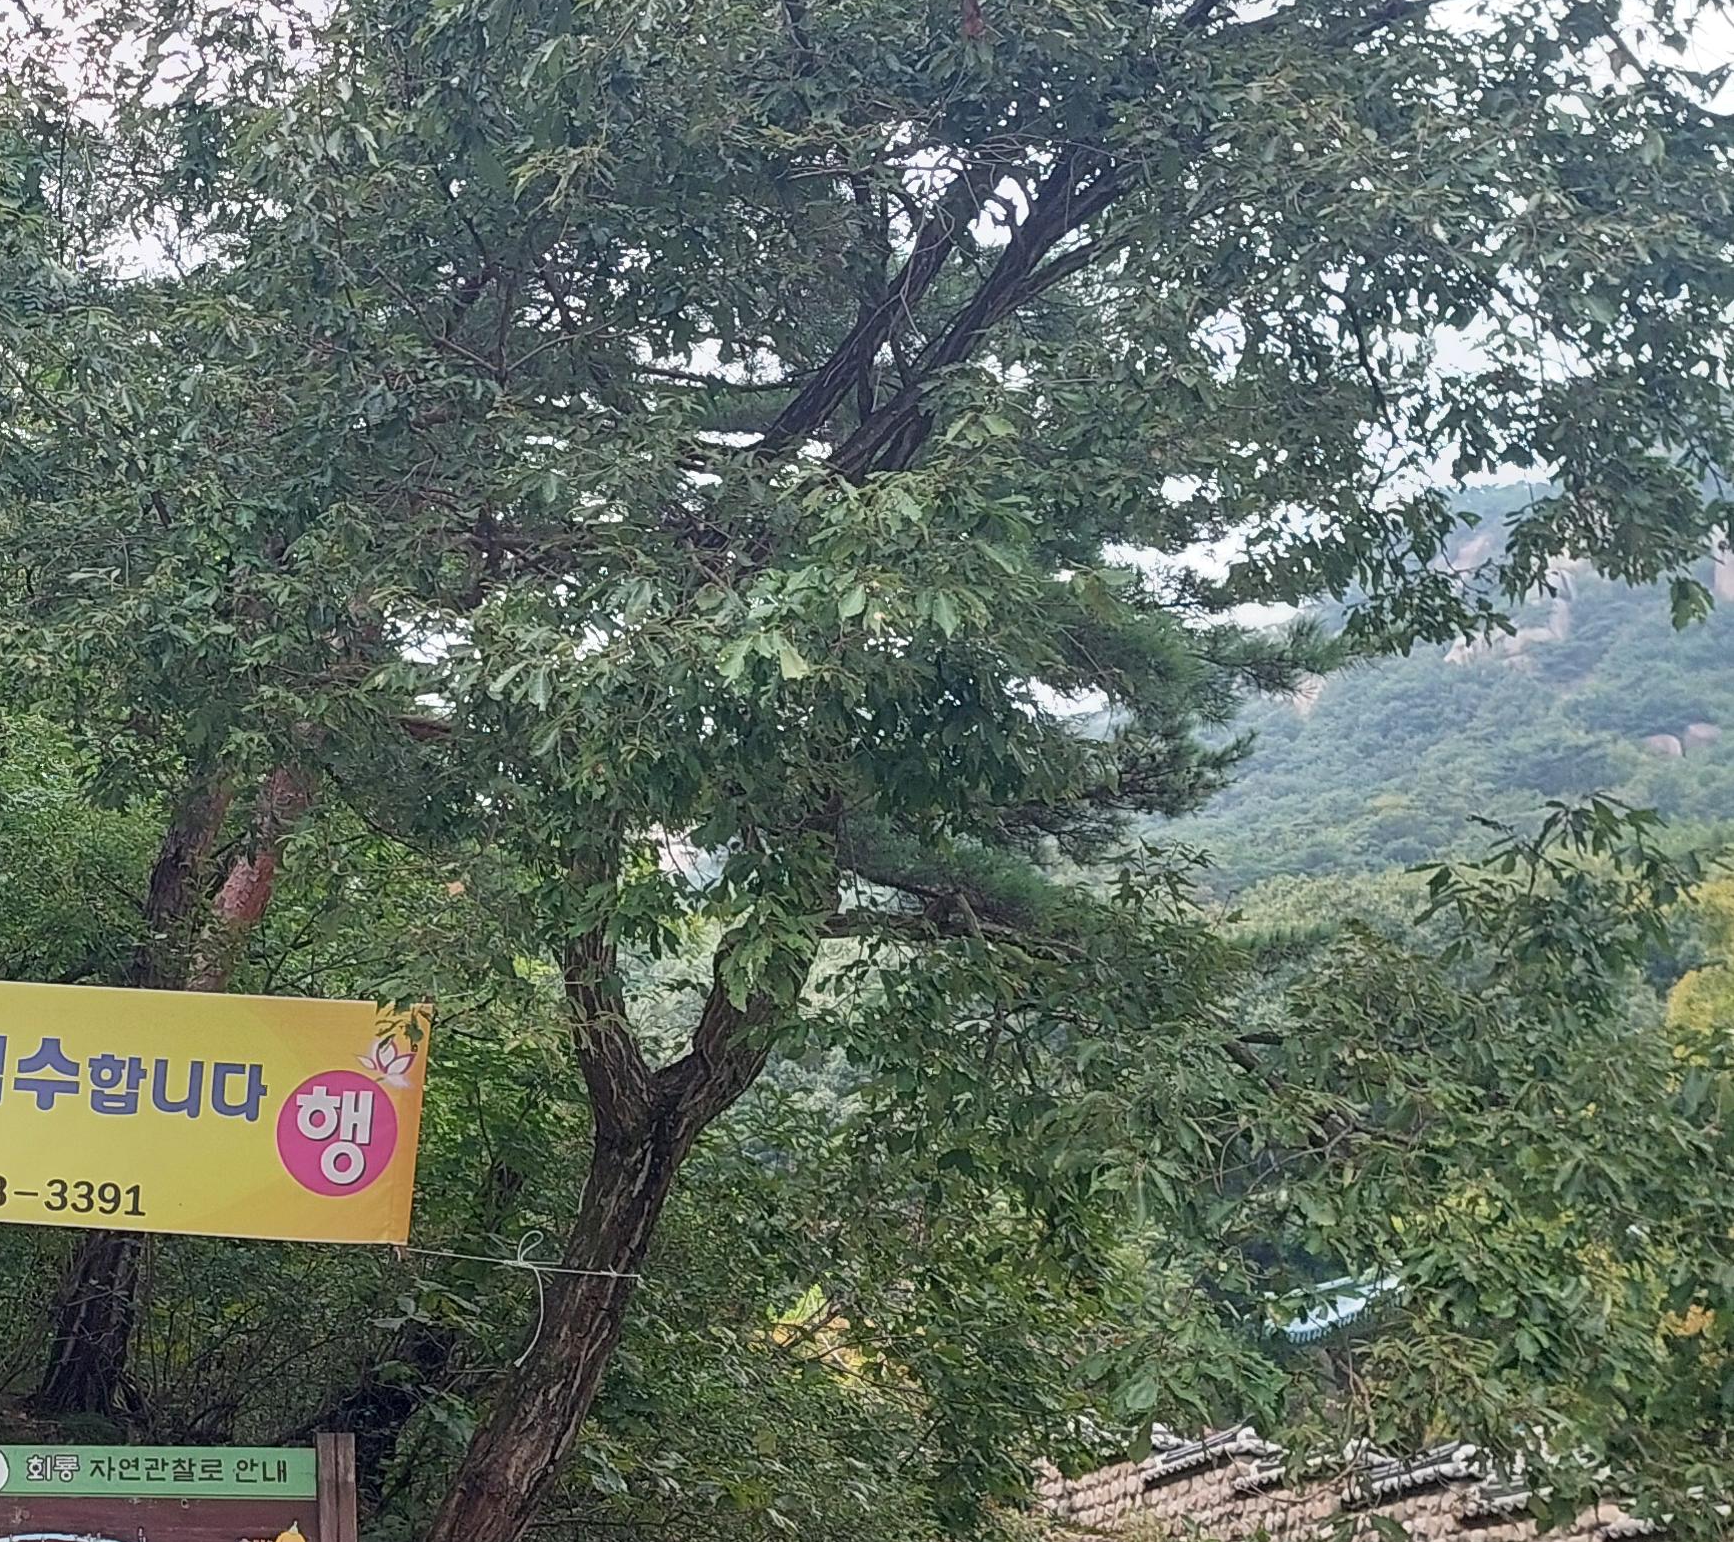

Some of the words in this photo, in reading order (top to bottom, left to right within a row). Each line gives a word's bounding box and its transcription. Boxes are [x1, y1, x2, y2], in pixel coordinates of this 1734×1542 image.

[295, 1086, 373, 1186] 행
[26, 1454, 80, 1482] 회룡
[90, 1457, 225, 1483] 자연관찰로
[234, 1459, 288, 1484] 안내
